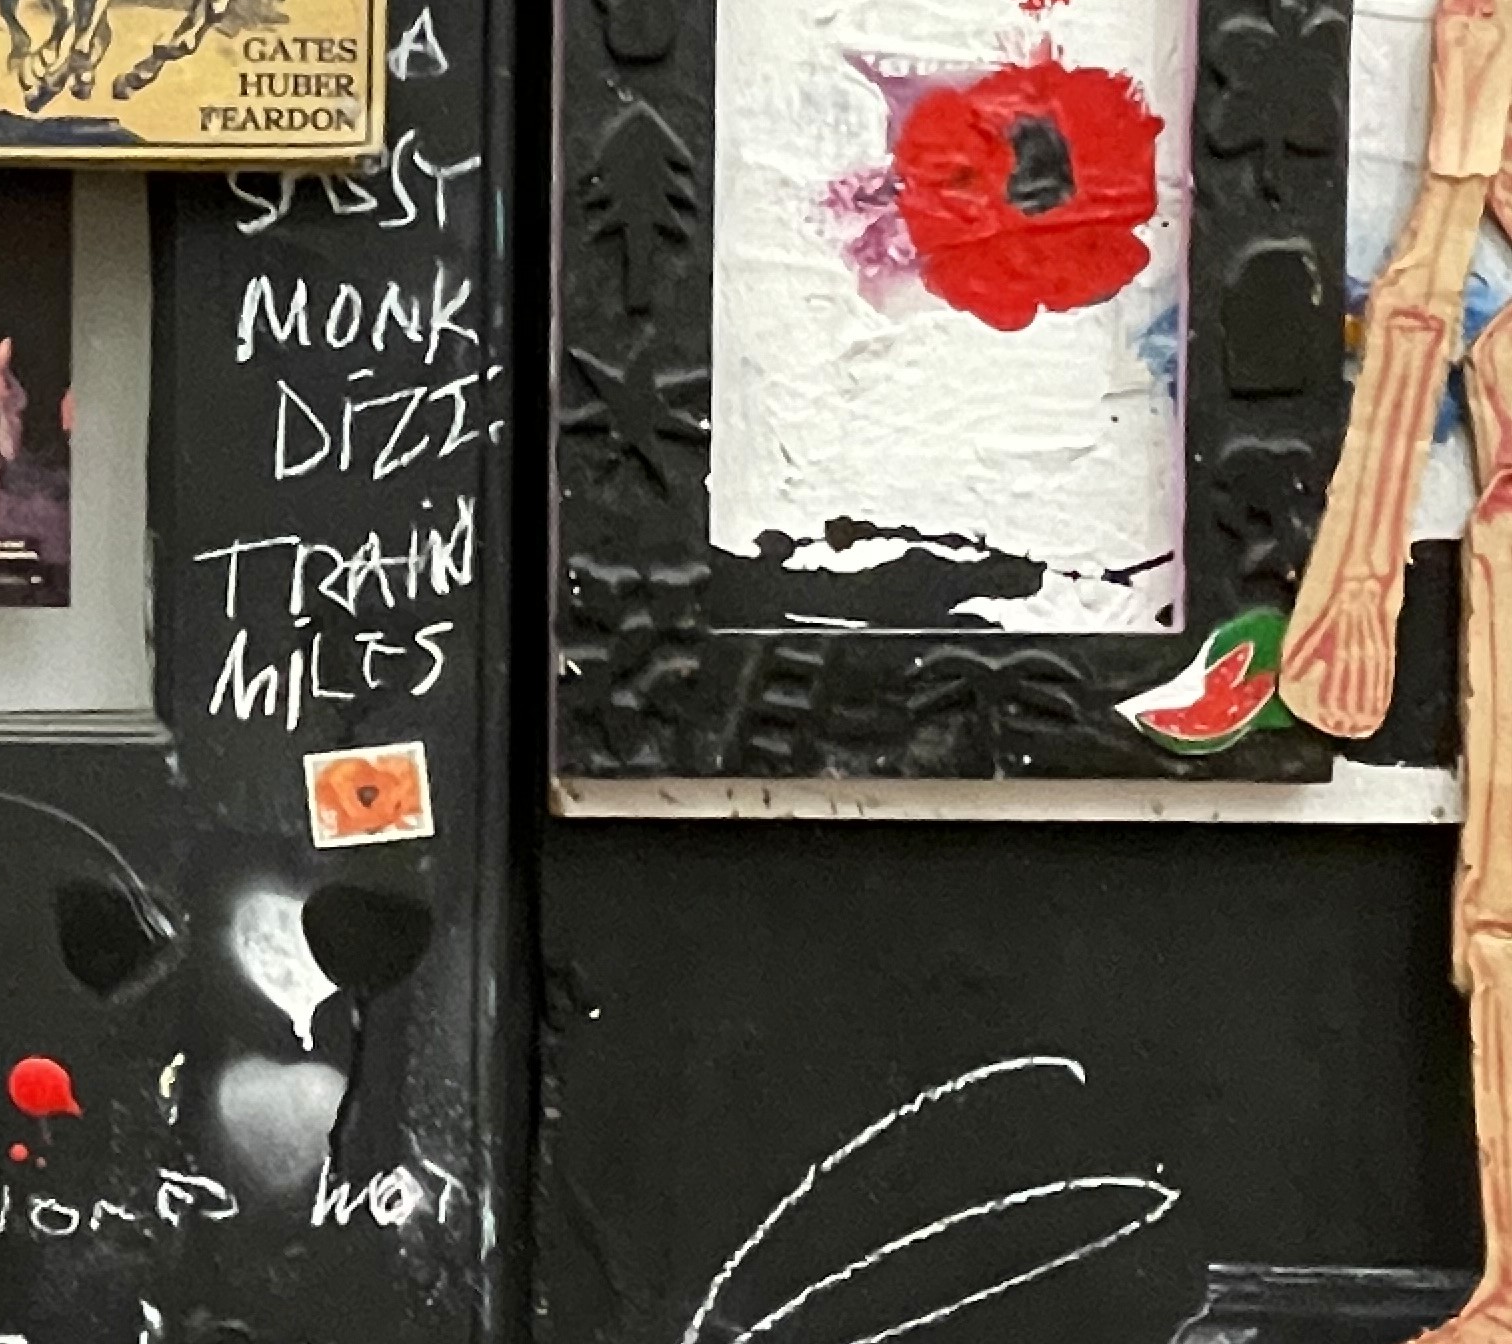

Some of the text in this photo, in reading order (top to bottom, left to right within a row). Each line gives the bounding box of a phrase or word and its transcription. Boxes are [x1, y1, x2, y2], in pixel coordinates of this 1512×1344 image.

[242, 36, 358, 64] GATES
[239, 72, 356, 99] HUBER
[237, 258, 480, 366] MONK
